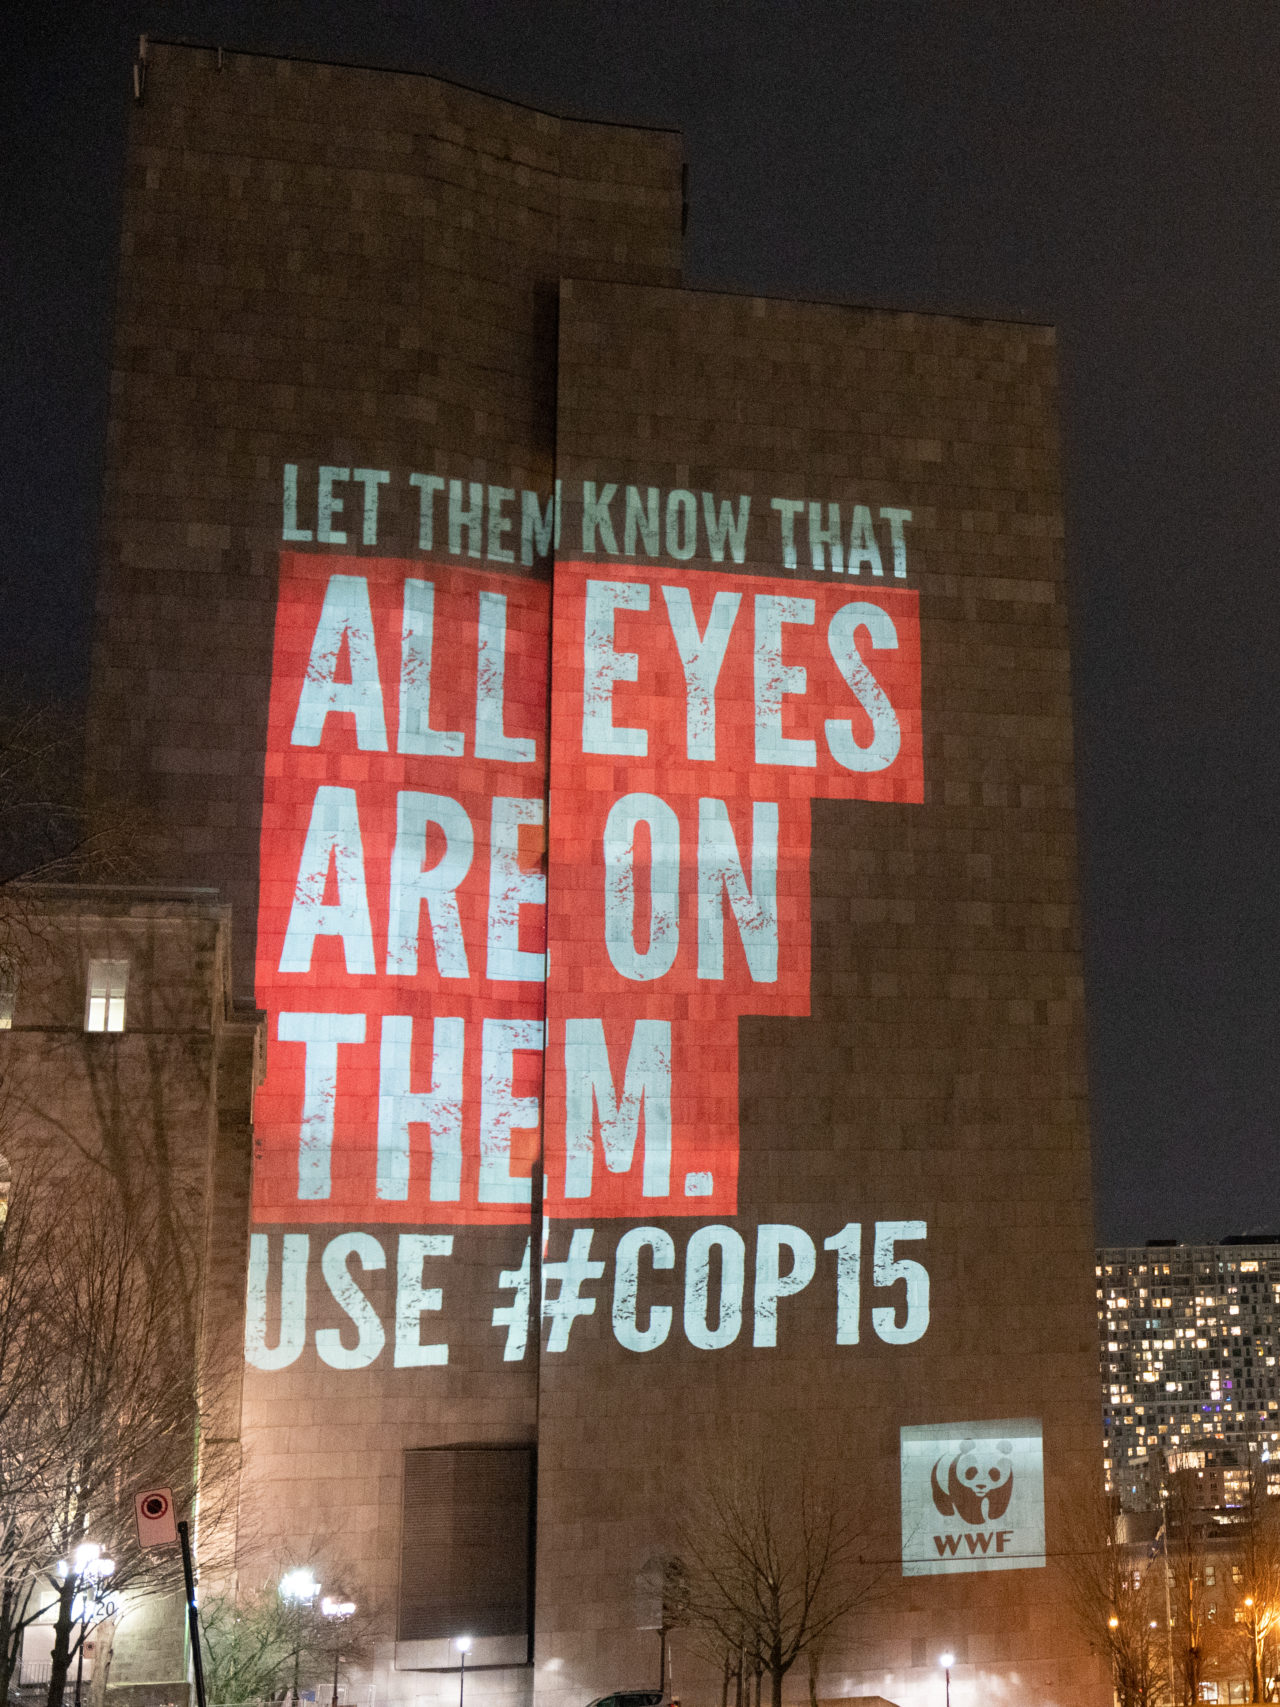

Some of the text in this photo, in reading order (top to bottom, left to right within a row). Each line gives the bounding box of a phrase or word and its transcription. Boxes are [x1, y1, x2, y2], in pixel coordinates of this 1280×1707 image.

[282, 463, 912, 579] LET THEM KNOW THAT
[290, 573, 900, 772] ALL EYES
[277, 785, 779, 983] ARE ON
[278, 1011, 714, 1204] THEM.
[244, 1232, 454, 1371] USE
[933, 1530, 1014, 1557] WWF
